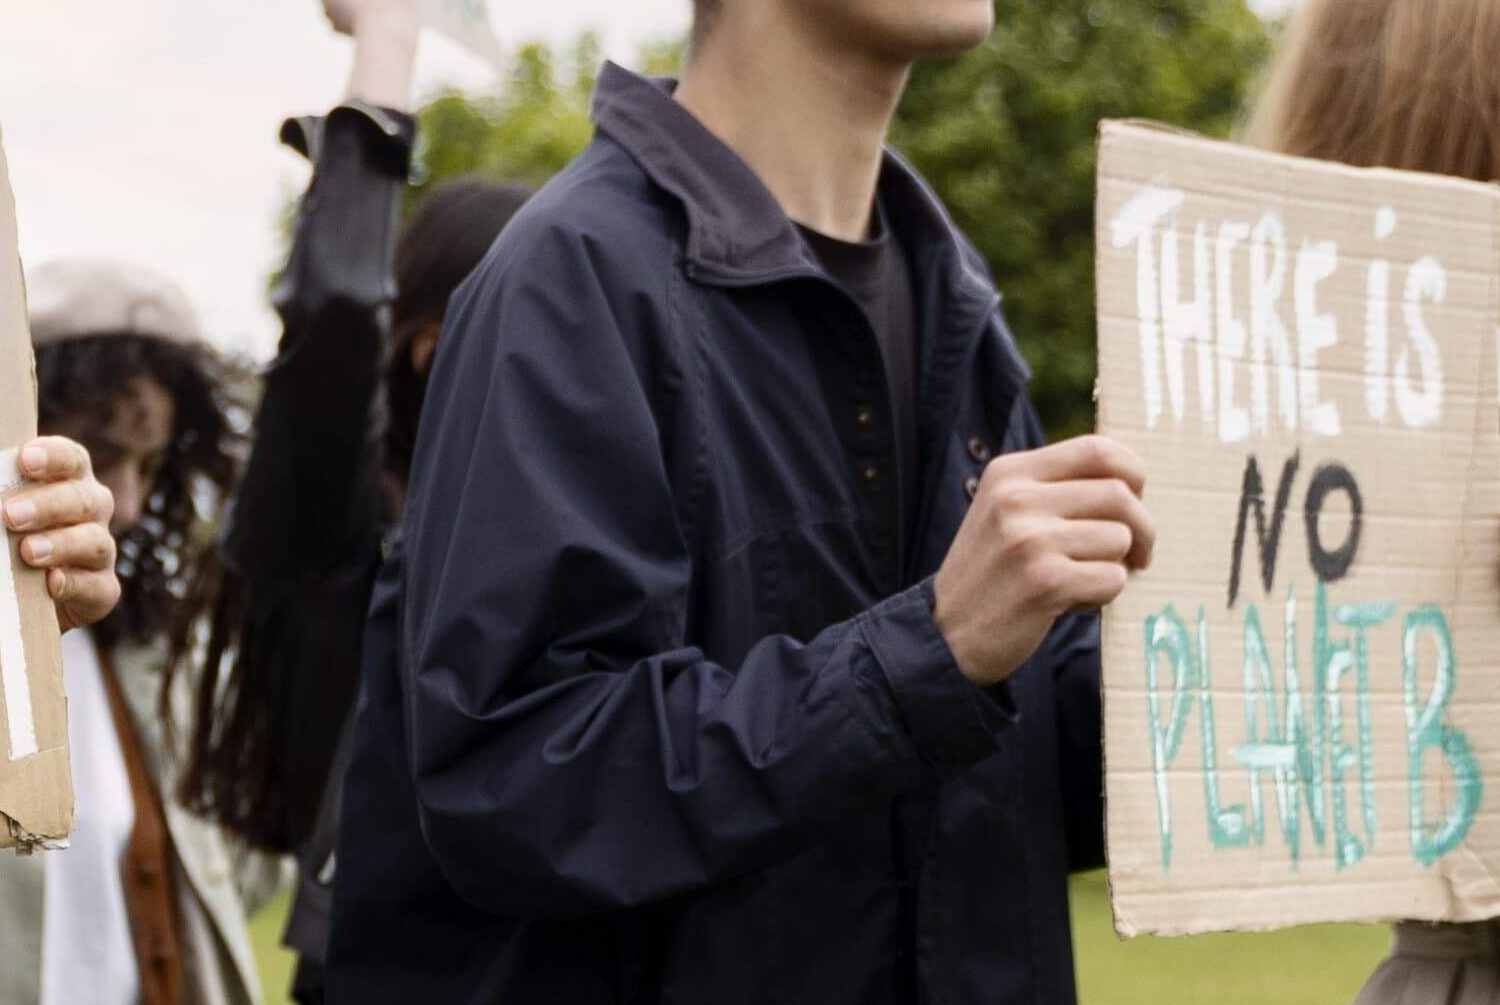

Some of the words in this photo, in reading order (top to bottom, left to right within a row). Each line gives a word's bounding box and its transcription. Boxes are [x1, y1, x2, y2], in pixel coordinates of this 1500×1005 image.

[1111, 173, 1343, 445] THERE
[1226, 447, 1363, 609] NO
[1143, 577, 1396, 875] PLANET
[1402, 601, 1485, 868] B
